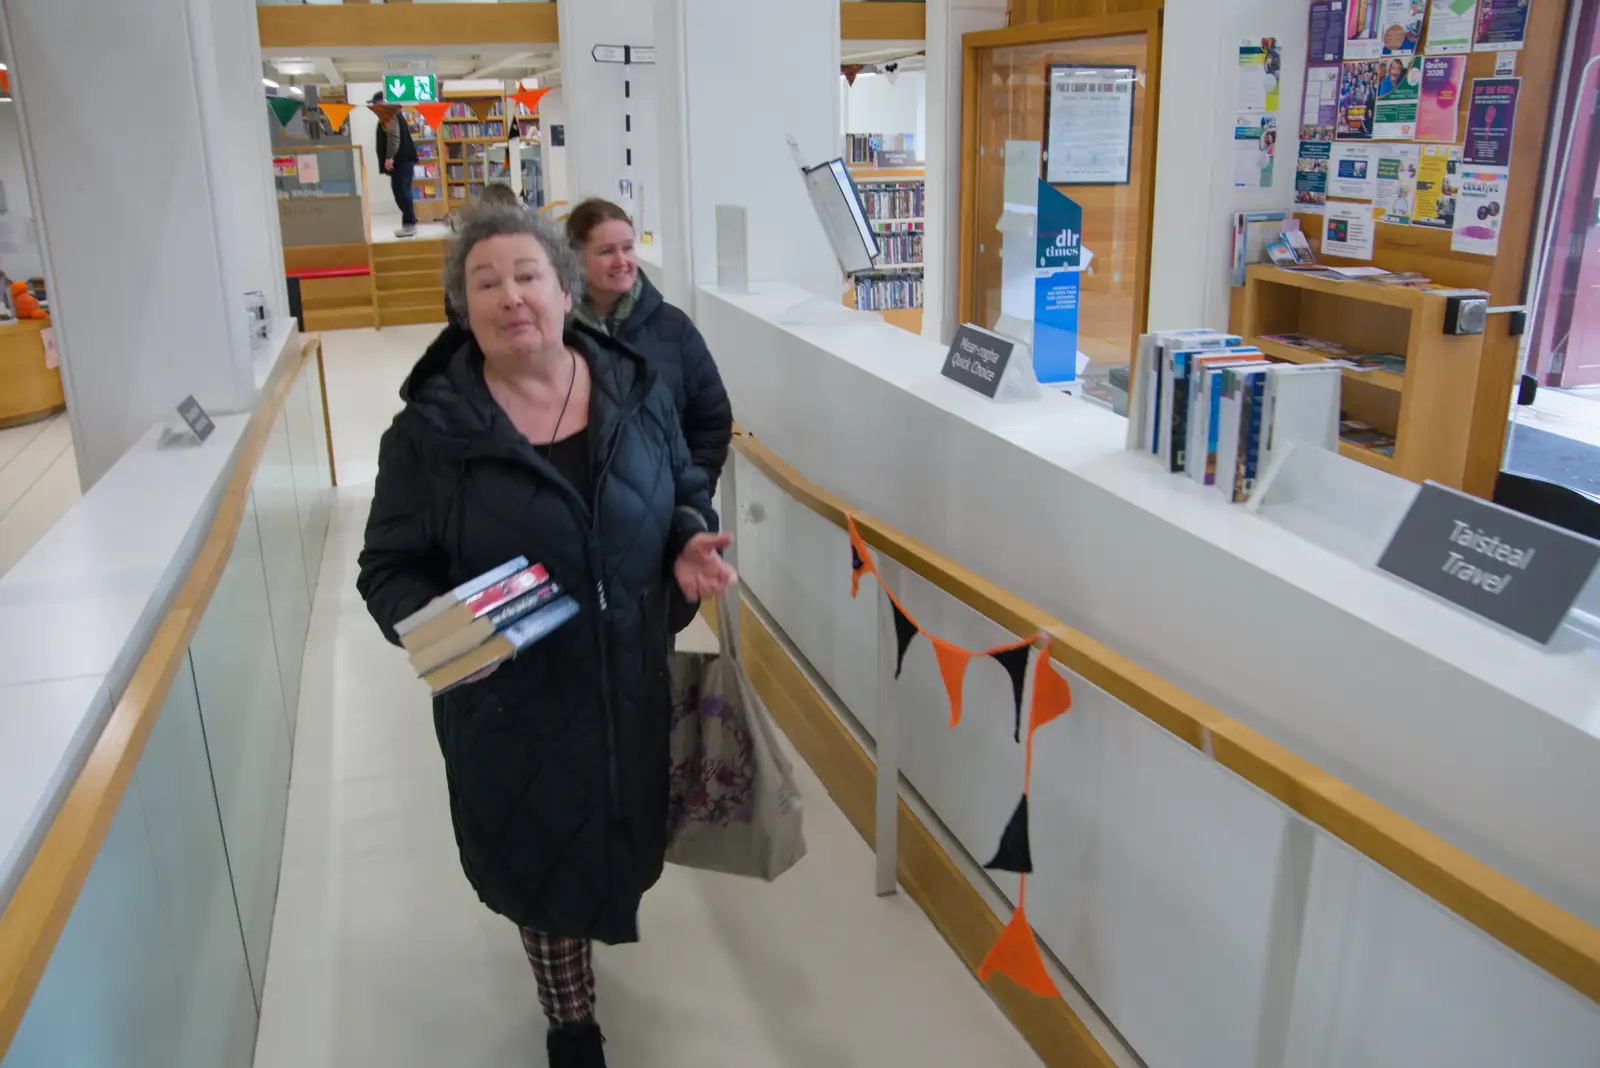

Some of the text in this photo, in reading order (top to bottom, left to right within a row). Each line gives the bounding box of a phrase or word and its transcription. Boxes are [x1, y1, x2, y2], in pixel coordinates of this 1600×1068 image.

[1045, 245, 1079, 257] times
[1055, 229, 1080, 248] dlr
[951, 352, 996, 382] Quick Choice
[1449, 519, 1536, 570] Taisteal
[1441, 551, 1513, 595] Travel
